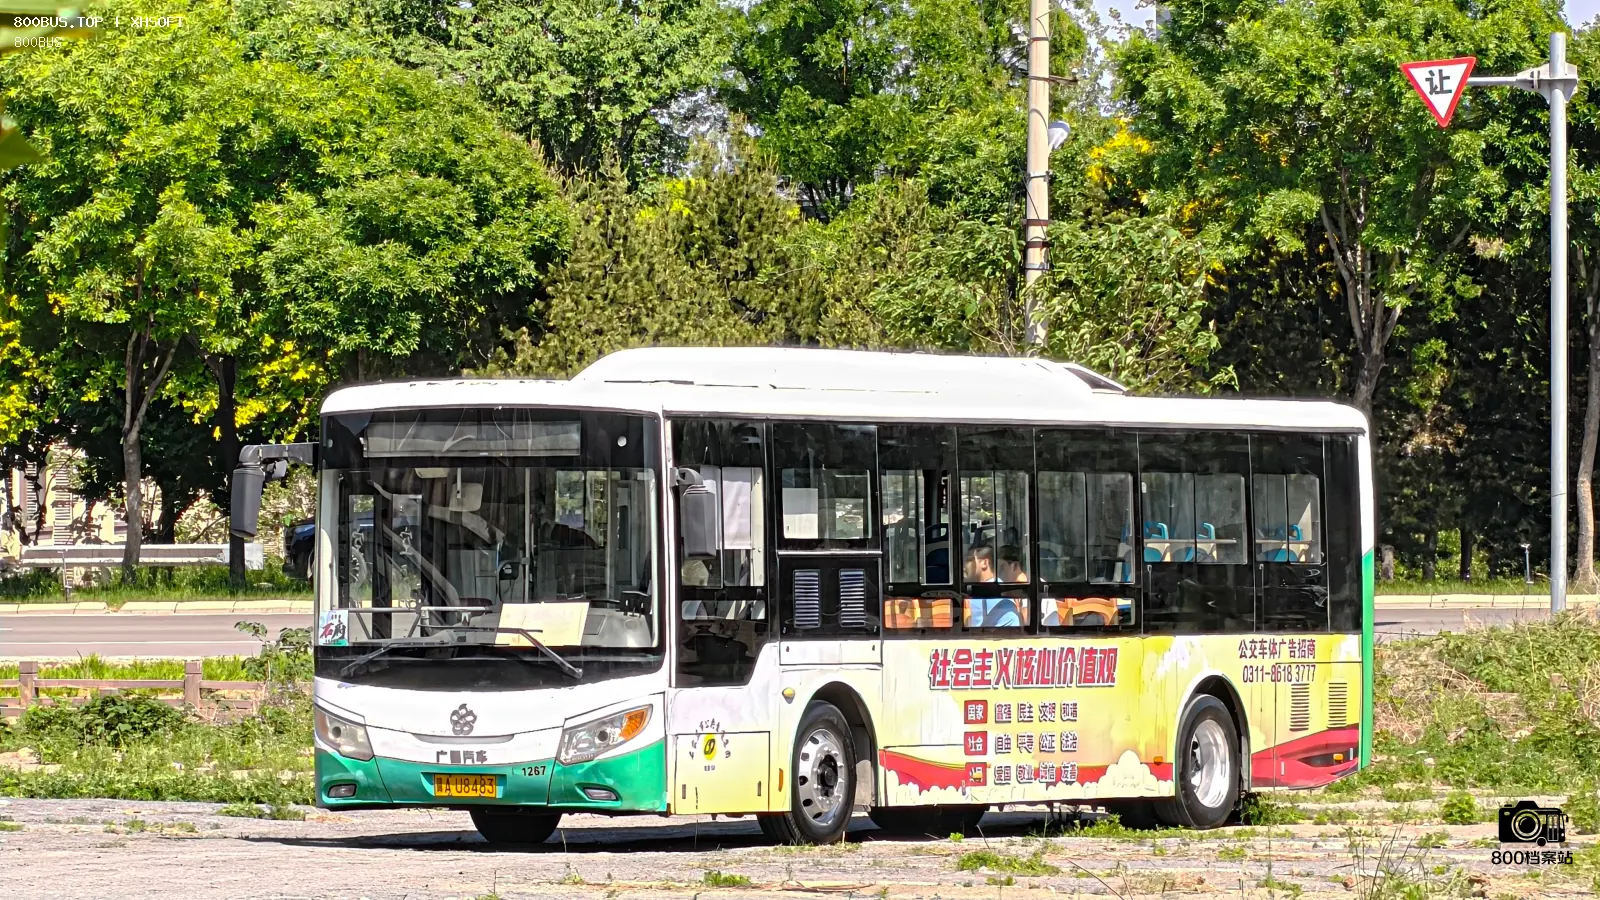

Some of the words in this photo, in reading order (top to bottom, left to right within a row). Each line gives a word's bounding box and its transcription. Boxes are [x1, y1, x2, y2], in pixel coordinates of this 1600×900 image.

[1425, 69, 1452, 95] 让
[1238, 638, 1316, 660] 公交车体广告招商
[929, 646, 1118, 689] 社会主义核心价值观
[1018, 702, 1034, 722] 民主
[1039, 702, 1056, 722] 文明
[1040, 732, 1056, 752] 公正
[436, 750, 488, 764] 广汽车
[521, 765, 547, 777] 1267
